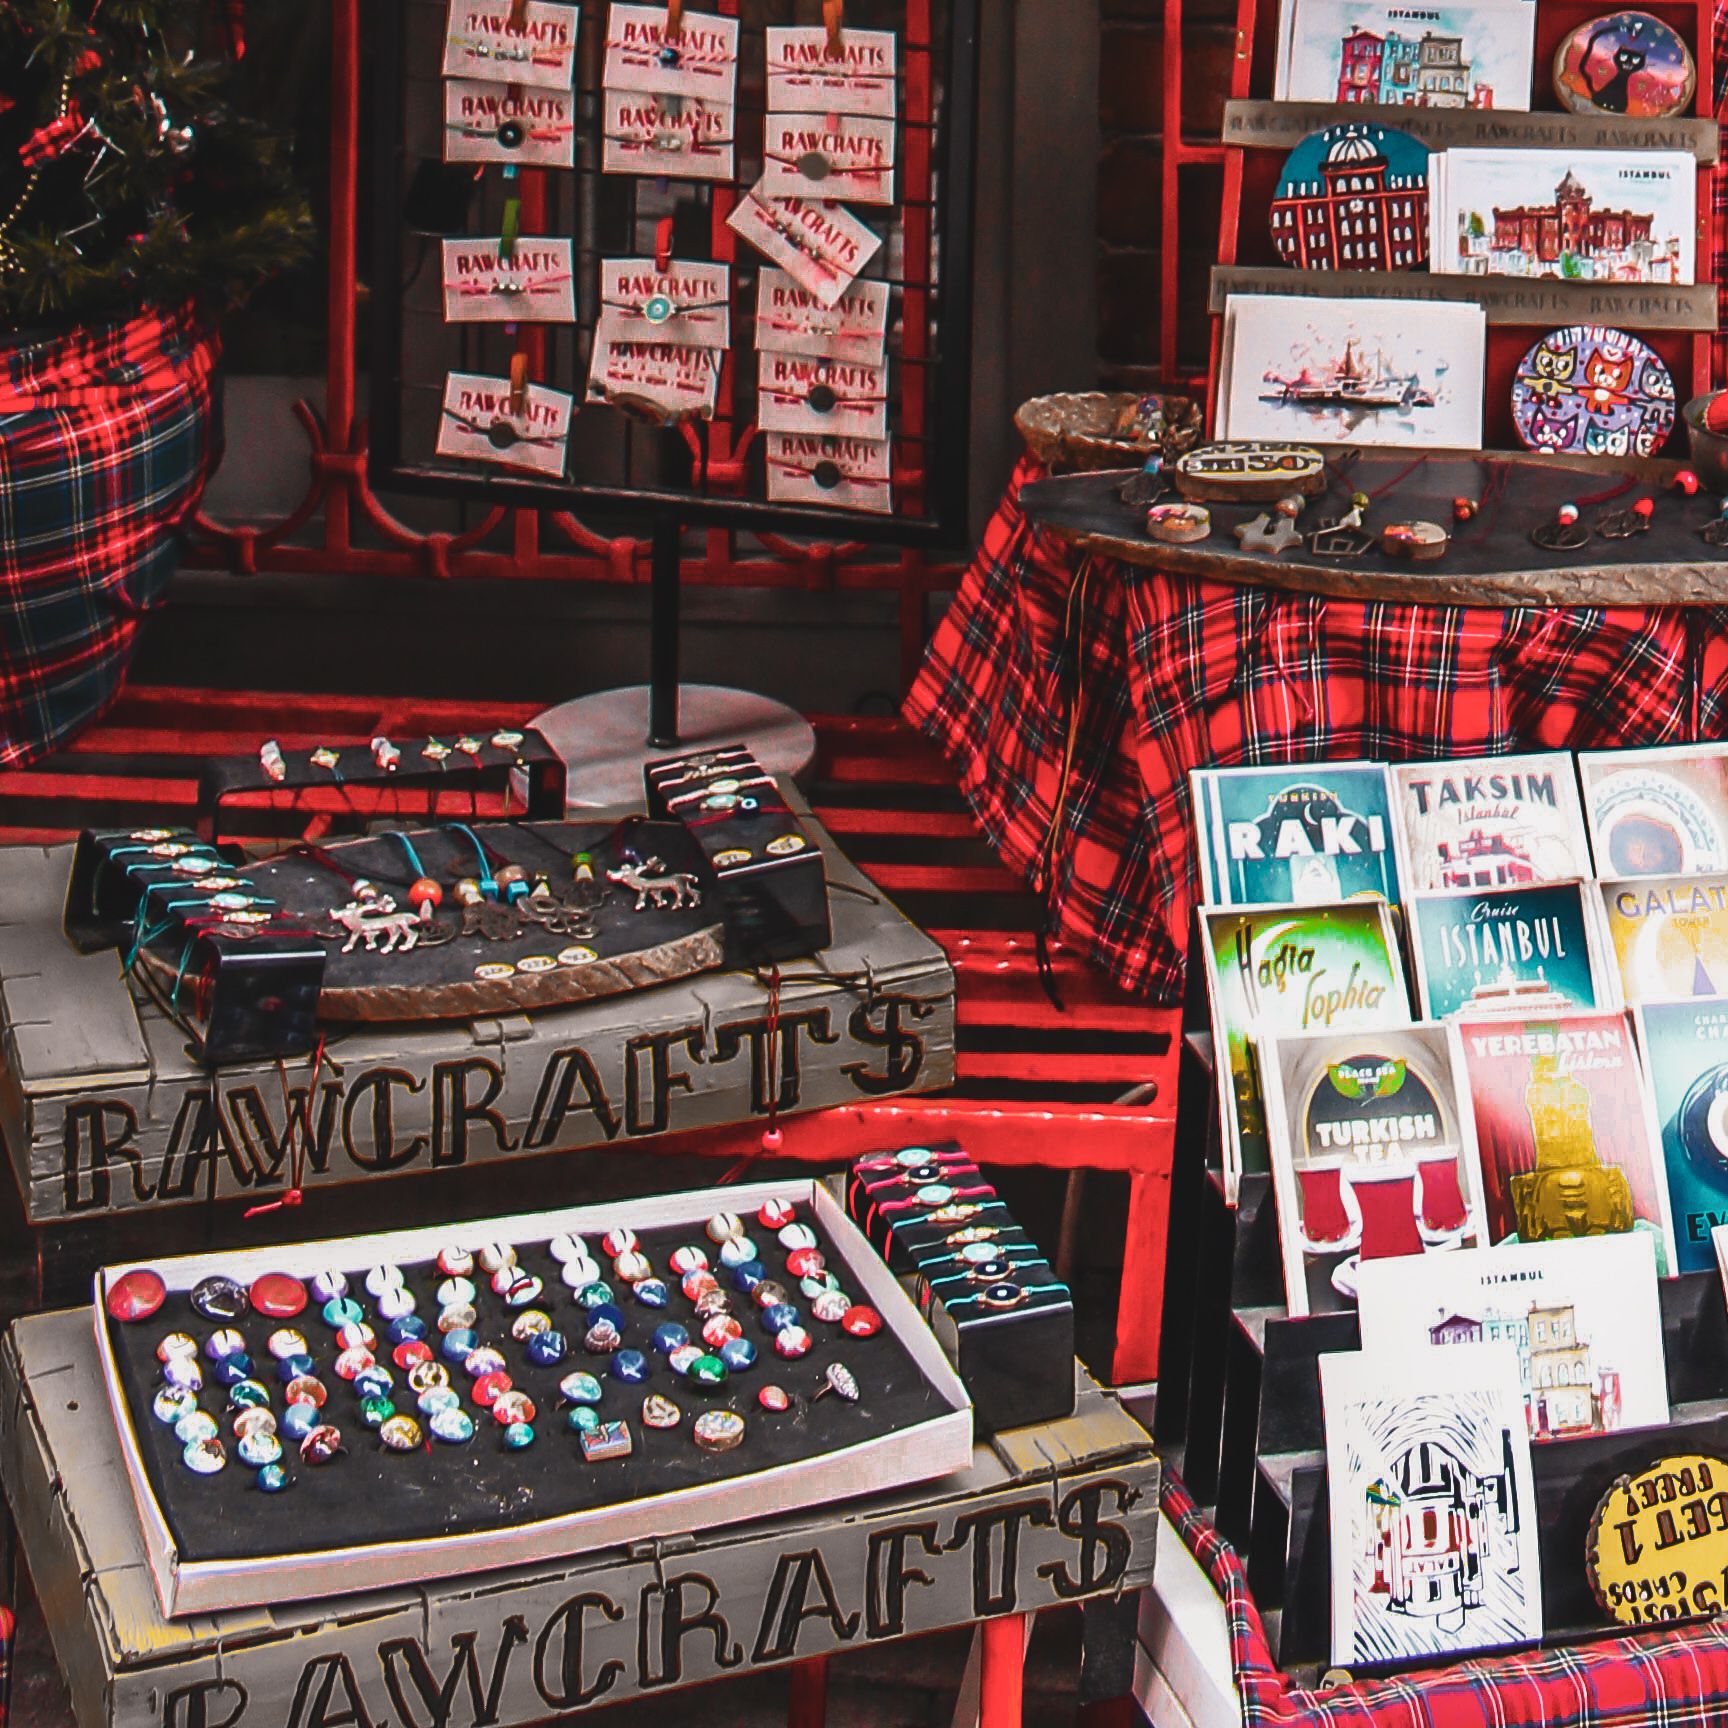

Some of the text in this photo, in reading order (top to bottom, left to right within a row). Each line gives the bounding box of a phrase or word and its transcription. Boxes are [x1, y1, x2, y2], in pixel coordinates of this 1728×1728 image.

[781, 129, 884, 157] RAWCRAFTS
[1618, 169, 1672, 180] ISTANBUL
[1408, 772, 1558, 817] TAKSIM
[1228, 814, 1387, 862] RAKI
[1470, 900, 1520, 923] Cruise
[1439, 915, 1567, 969] ISTANBUL
[1235, 923, 1316, 1020] Hagia
[1301, 962, 1387, 1031] Sophia
[1470, 1028, 1622, 1058] YEREBATAN
[62, 992, 936, 1216] RAWCRAFTS
[1315, 1113, 1437, 1148] TURKISH
[1352, 1141, 1406, 1167] TEA
[1480, 1269, 1544, 1286] ISTANBUL
[1612, 1518, 1645, 1567] 1
[1607, 1569, 1689, 1608] CARDS
